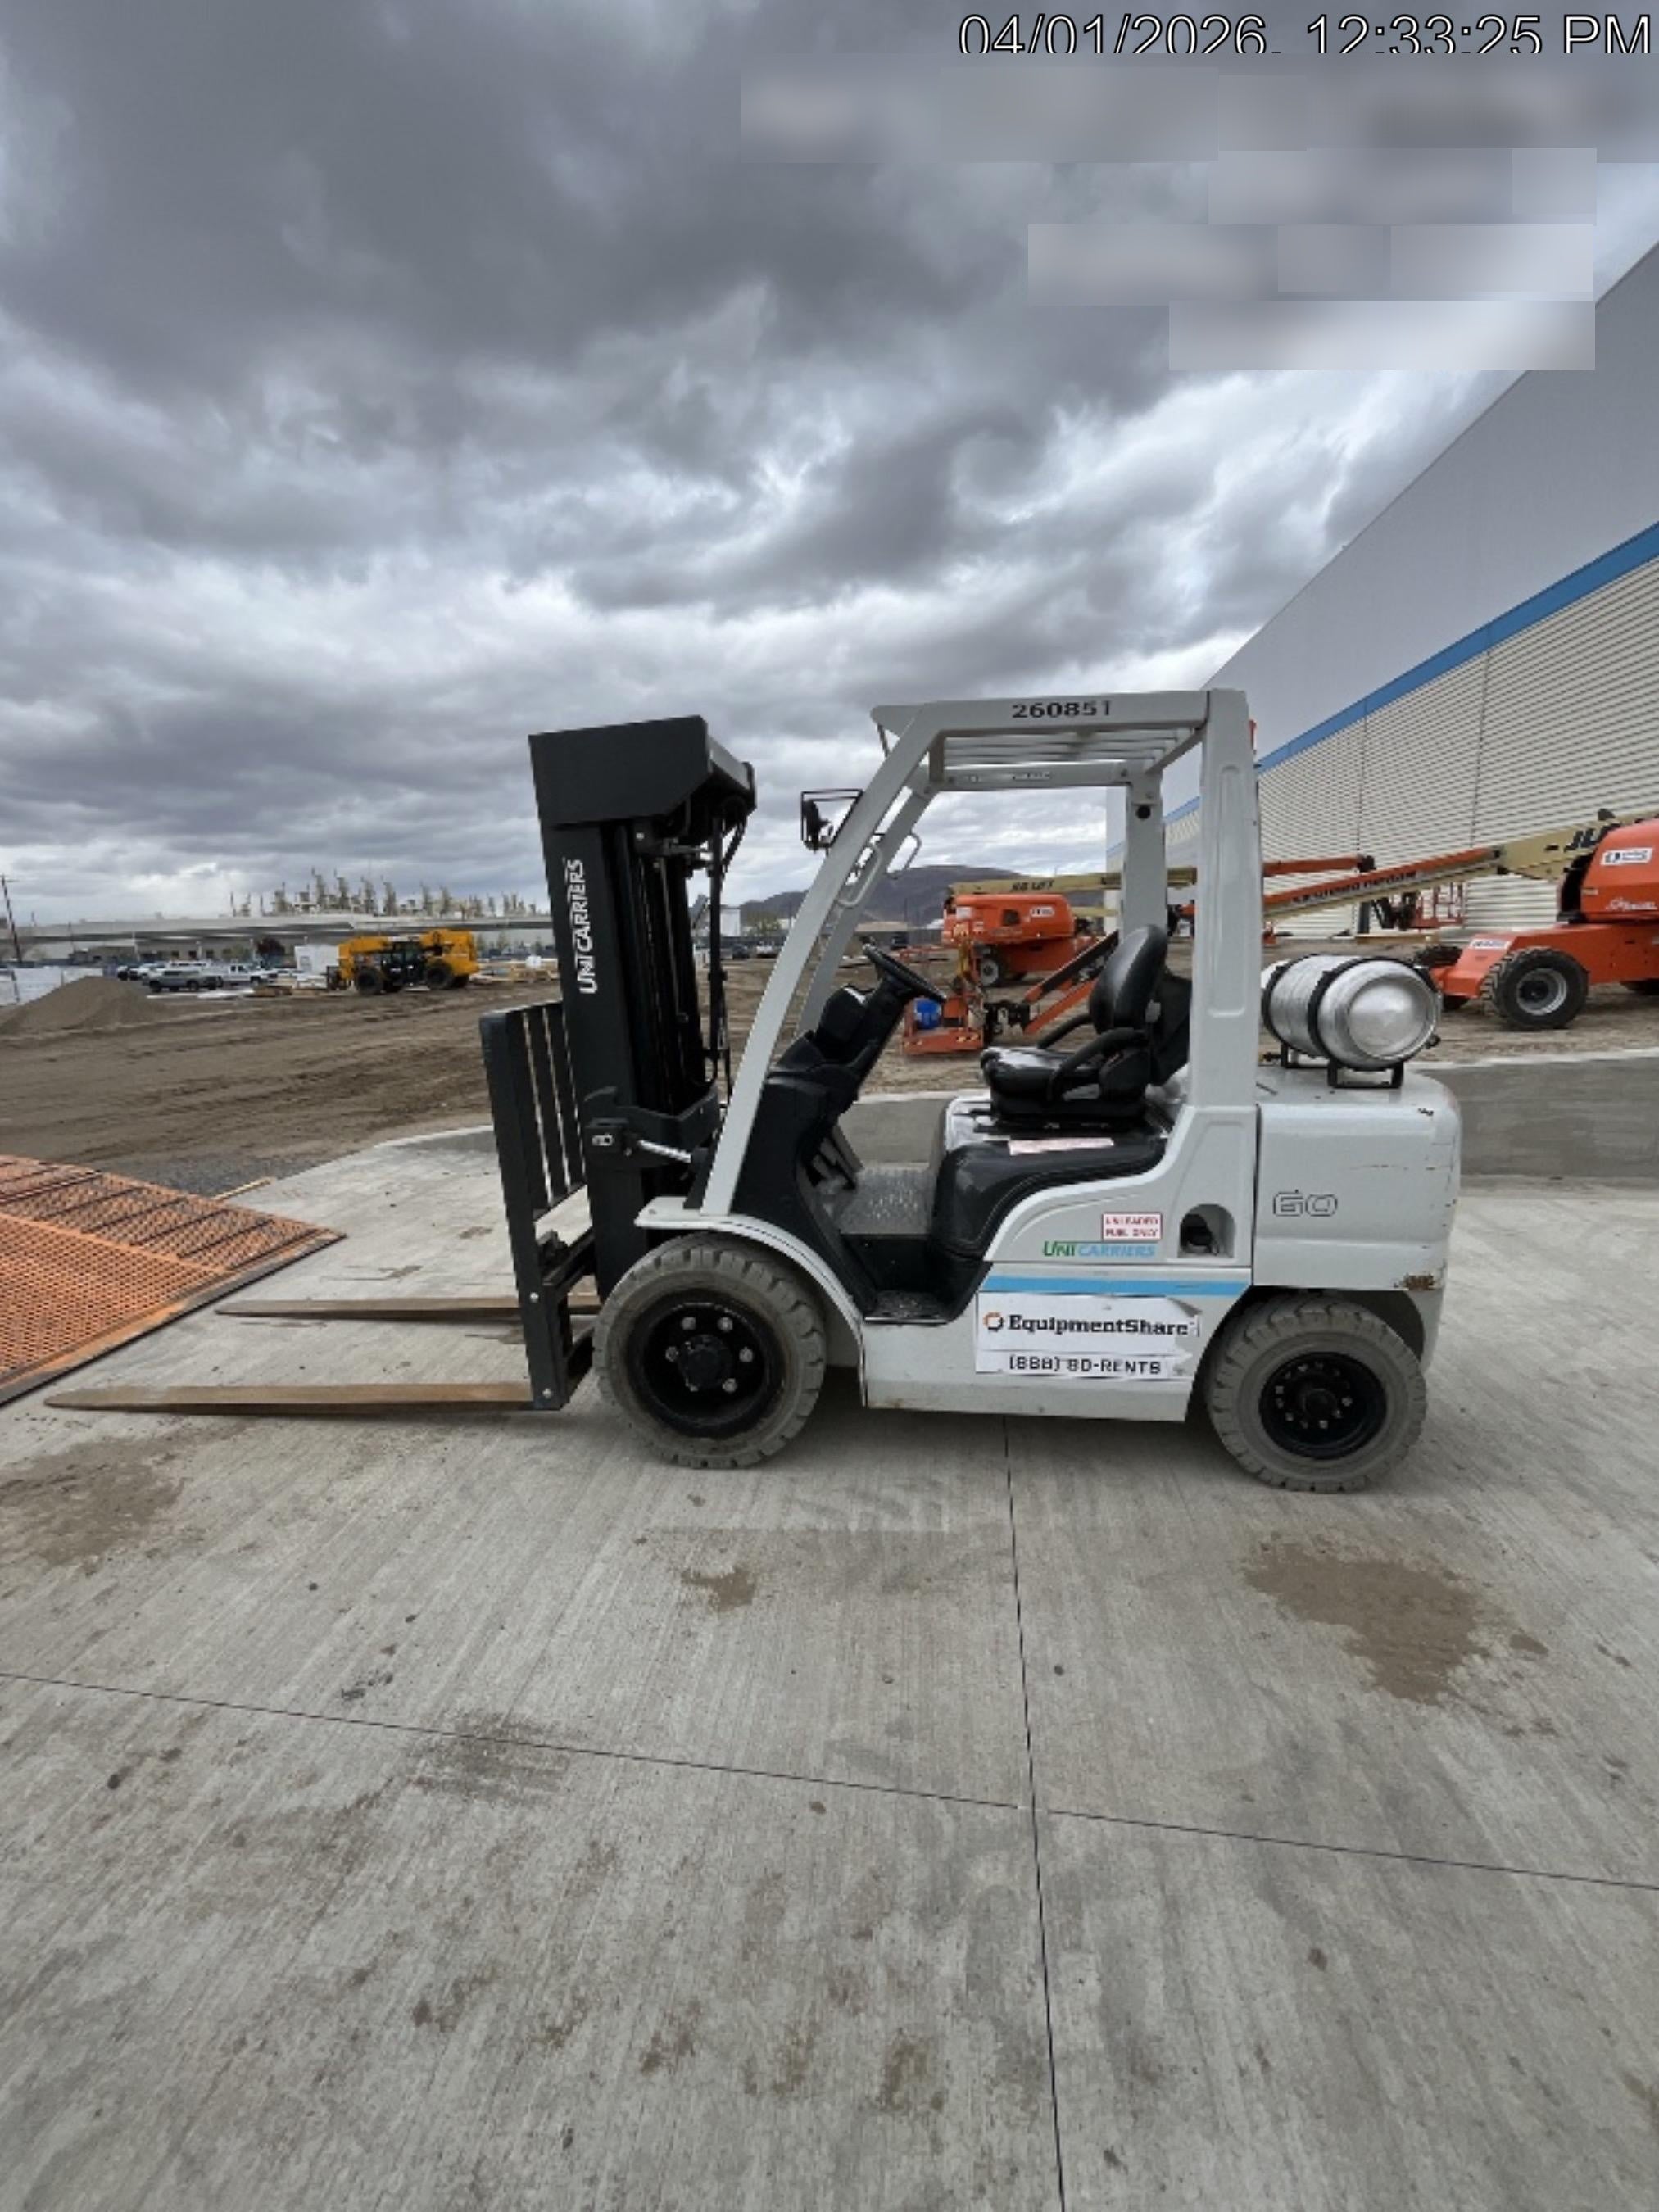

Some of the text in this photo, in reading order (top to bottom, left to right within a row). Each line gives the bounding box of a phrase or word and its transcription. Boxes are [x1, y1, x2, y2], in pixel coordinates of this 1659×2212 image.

[1012, 700, 1110, 718] 260851
[1009, 1314, 1188, 1335] EquipmentShare
[1009, 1356, 1060, 1371] (888)
